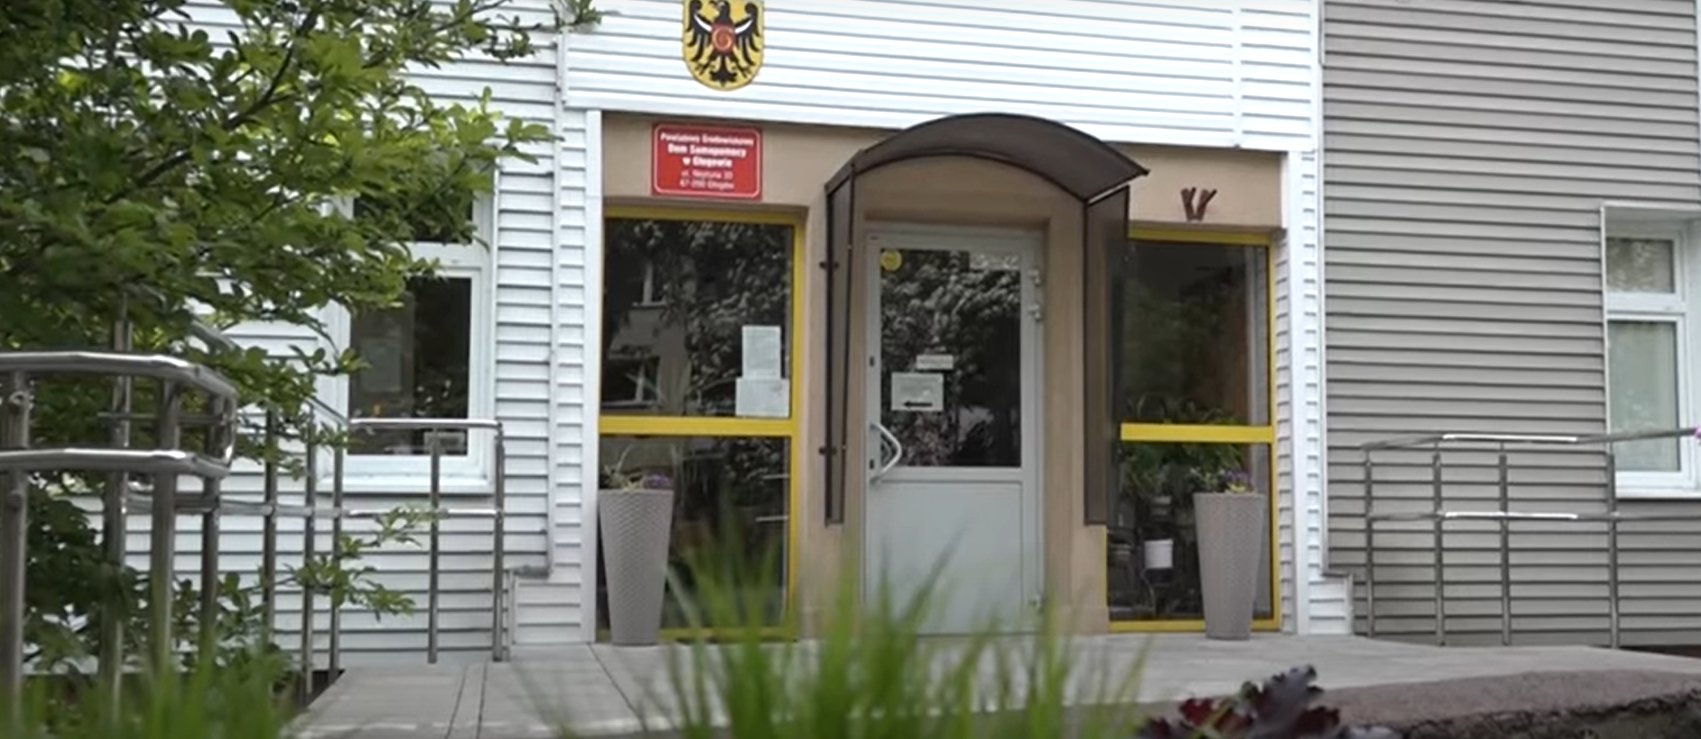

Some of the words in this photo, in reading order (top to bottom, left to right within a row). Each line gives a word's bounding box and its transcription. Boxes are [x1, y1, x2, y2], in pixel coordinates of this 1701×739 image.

[667, 143, 688, 154] Dom
[689, 144, 747, 158] Samopomocy
[682, 157, 691, 166] w
